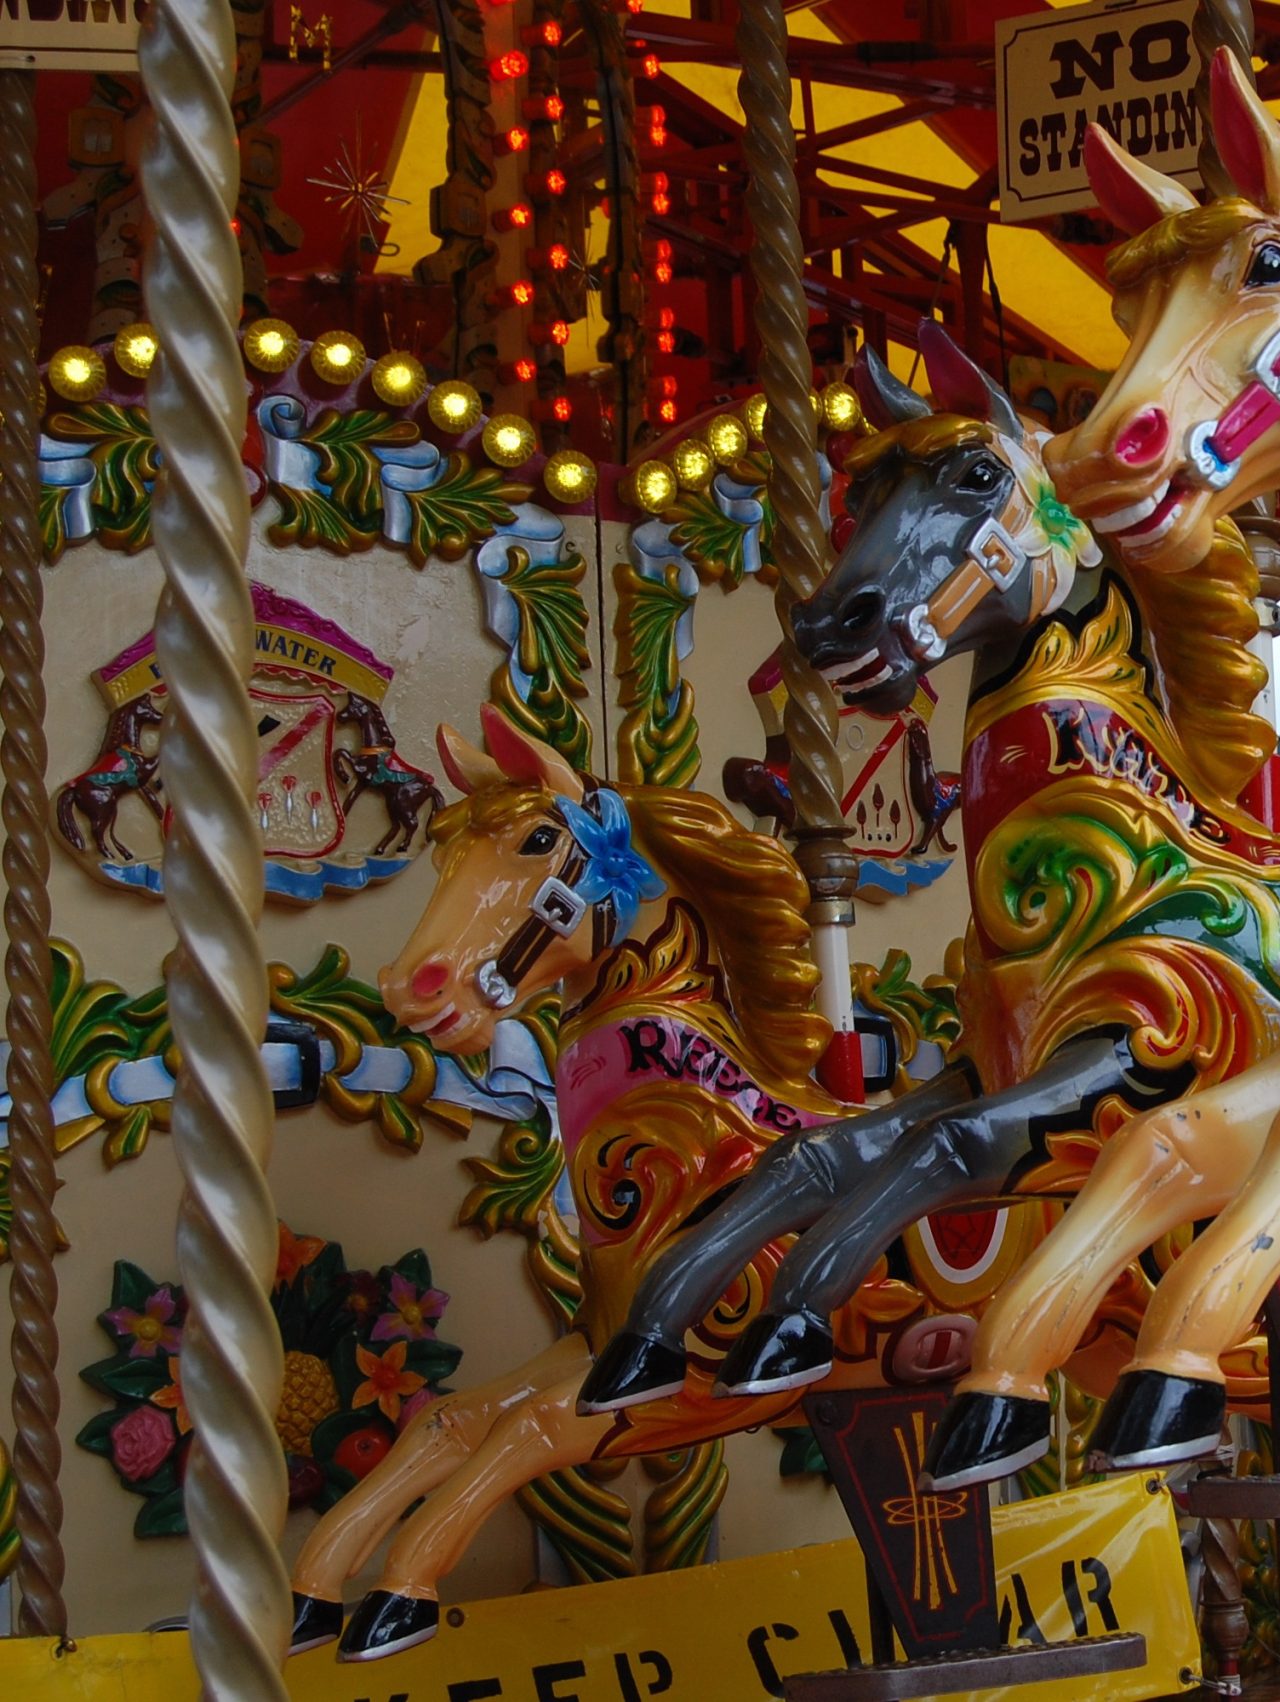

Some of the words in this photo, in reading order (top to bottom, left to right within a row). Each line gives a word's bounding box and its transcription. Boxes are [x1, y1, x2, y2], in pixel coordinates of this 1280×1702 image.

[1049, 19, 1192, 100] NO
[1018, 87, 1199, 177] STANDIN
[353, 1650, 673, 1702] EP
[747, 1557, 1120, 1699] CLAR
